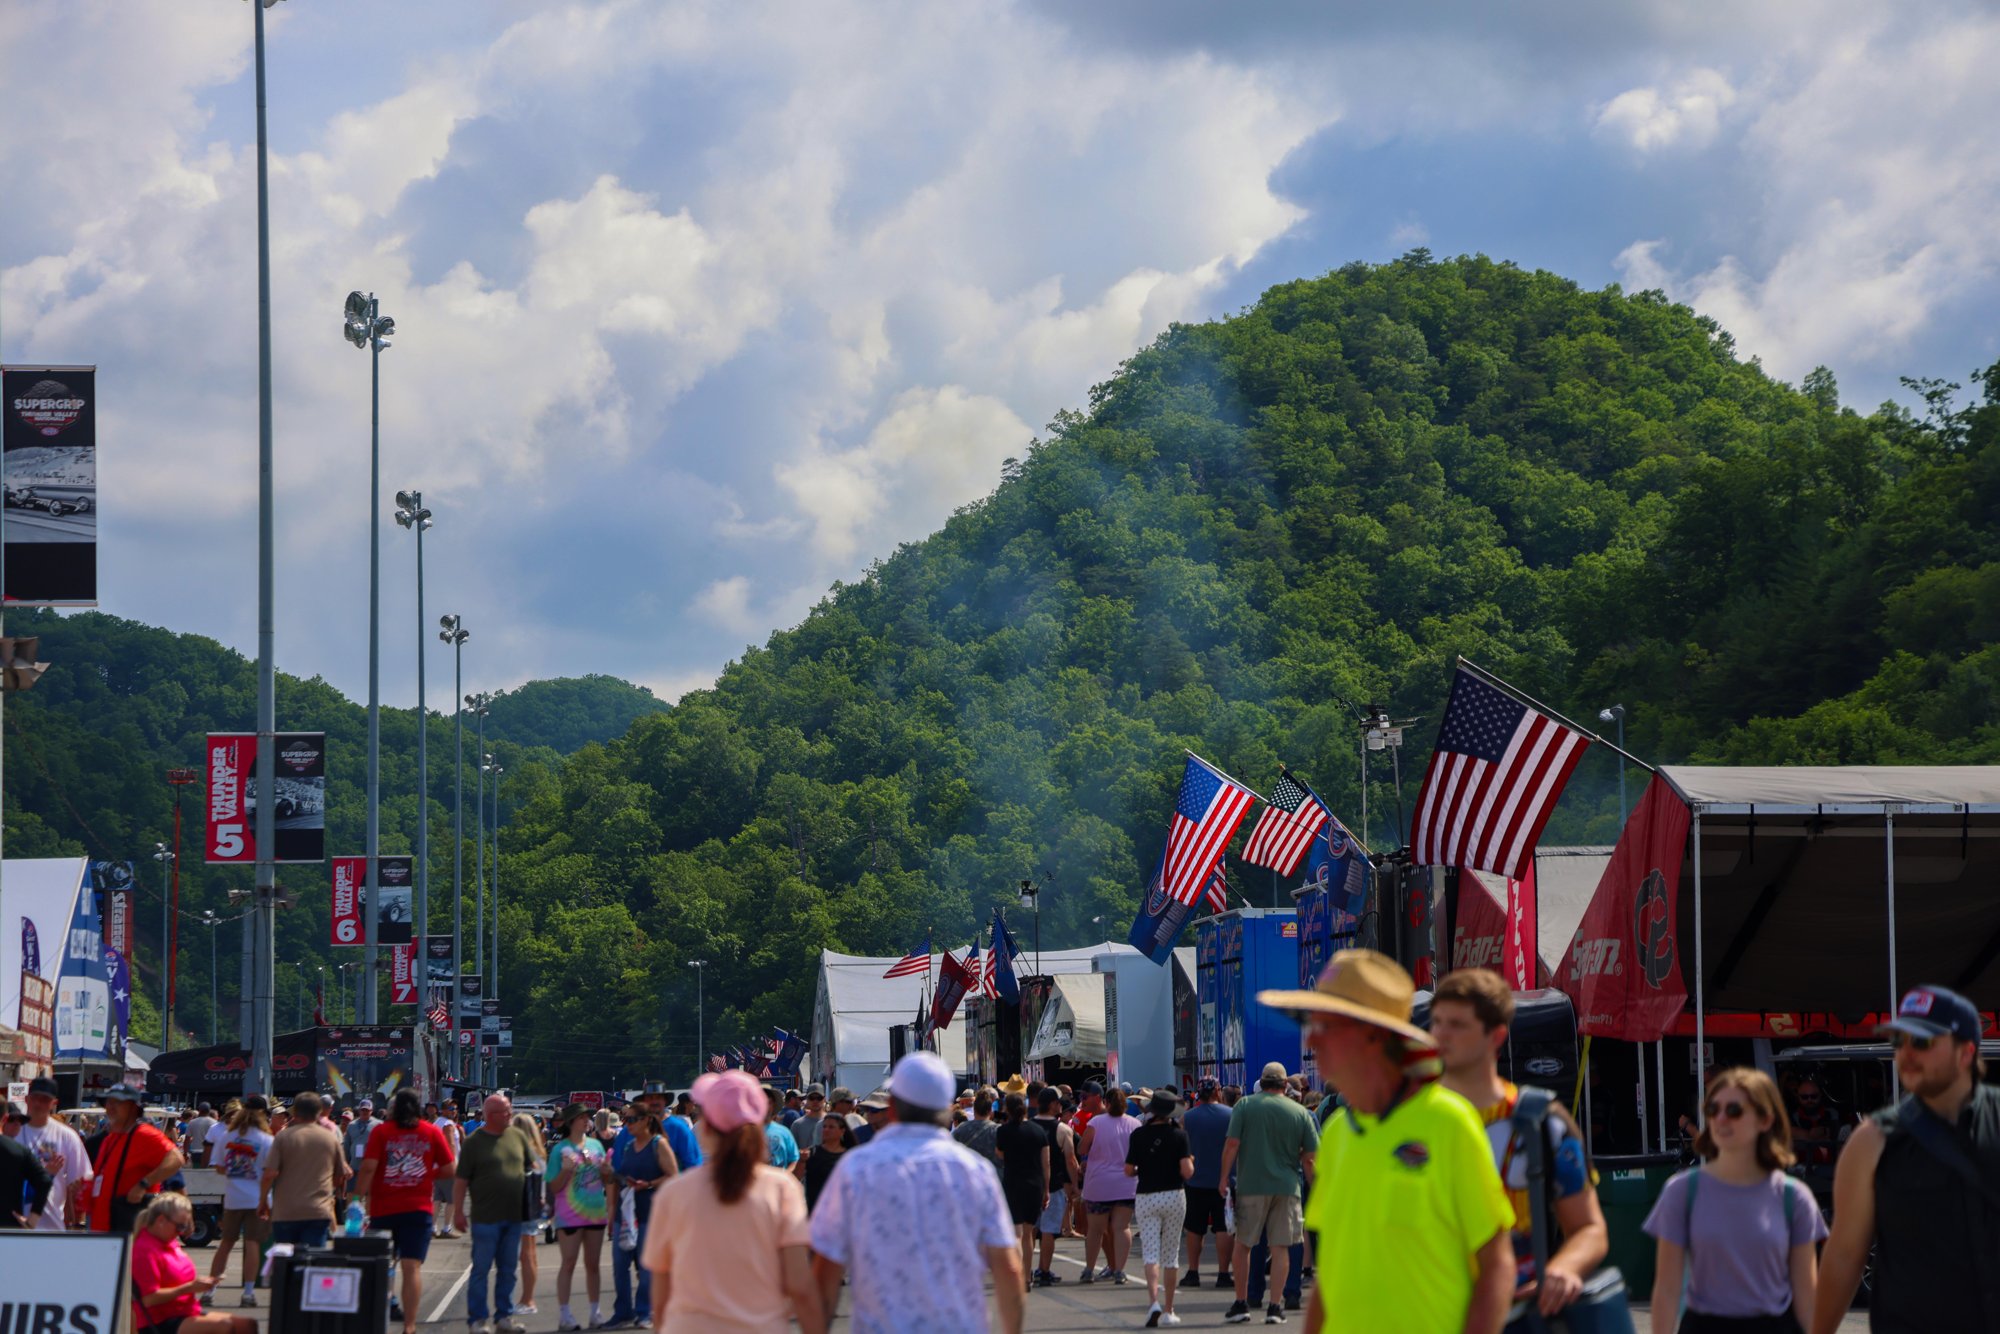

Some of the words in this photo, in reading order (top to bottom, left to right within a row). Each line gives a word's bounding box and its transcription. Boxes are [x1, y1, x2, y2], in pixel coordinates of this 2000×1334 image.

[14, 398, 85, 410] SUPERGRIP
[212, 746, 226, 822] THUNDER
[222, 765, 238, 820] VALLEY
[213, 823, 244, 857] 5
[335, 865, 346, 918] THUNDER
[342, 879, 353, 916] VALLEY
[337, 919, 357, 942] 6
[396, 984, 412, 1001] 7
